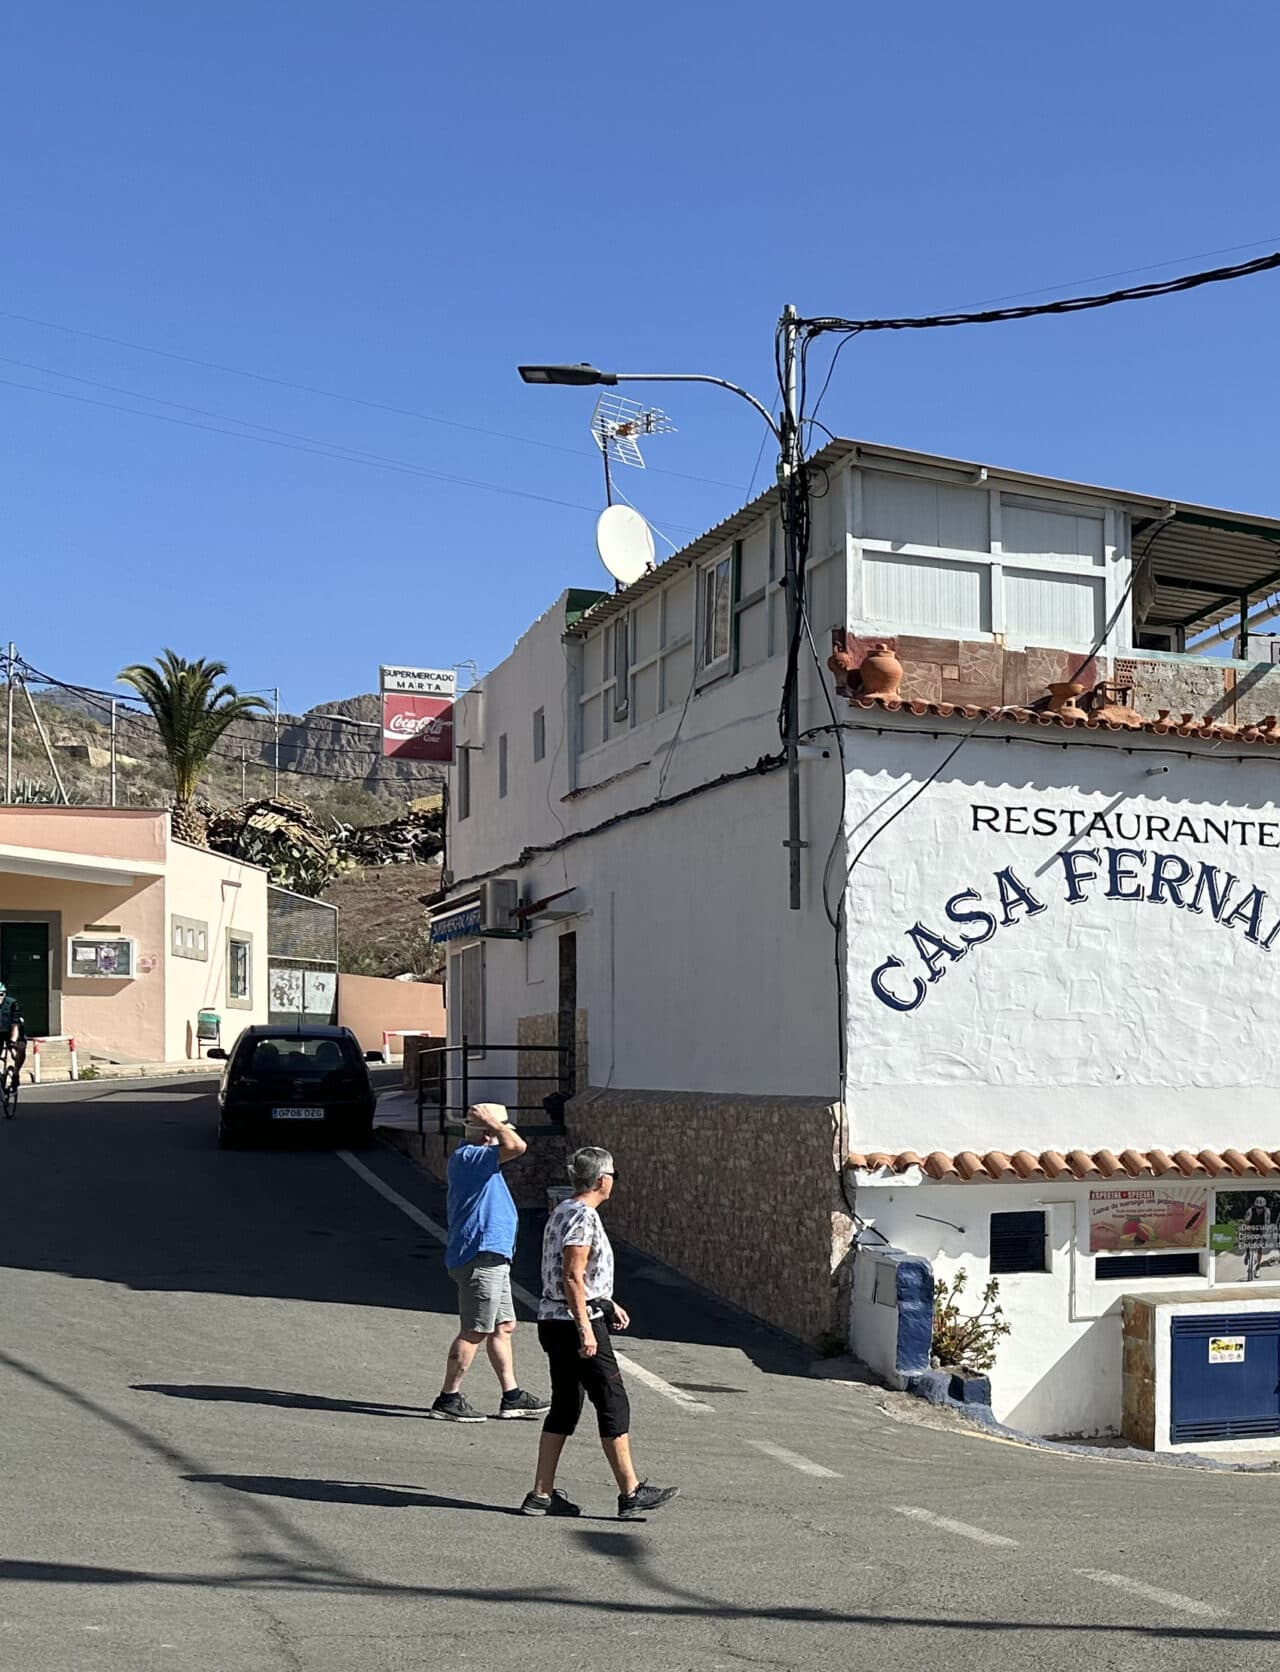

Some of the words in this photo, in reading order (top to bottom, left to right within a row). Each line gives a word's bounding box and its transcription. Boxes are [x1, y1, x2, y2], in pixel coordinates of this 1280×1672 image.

[384, 669, 455, 682] SUPERMERCADO
[396, 681, 441, 691] MARTA
[389, 713, 449, 734] Coca-Cola
[423, 734, 440, 743] Coke
[970, 804, 1280, 848] RESTAURANTE
[870, 865, 1047, 1012] CASA
